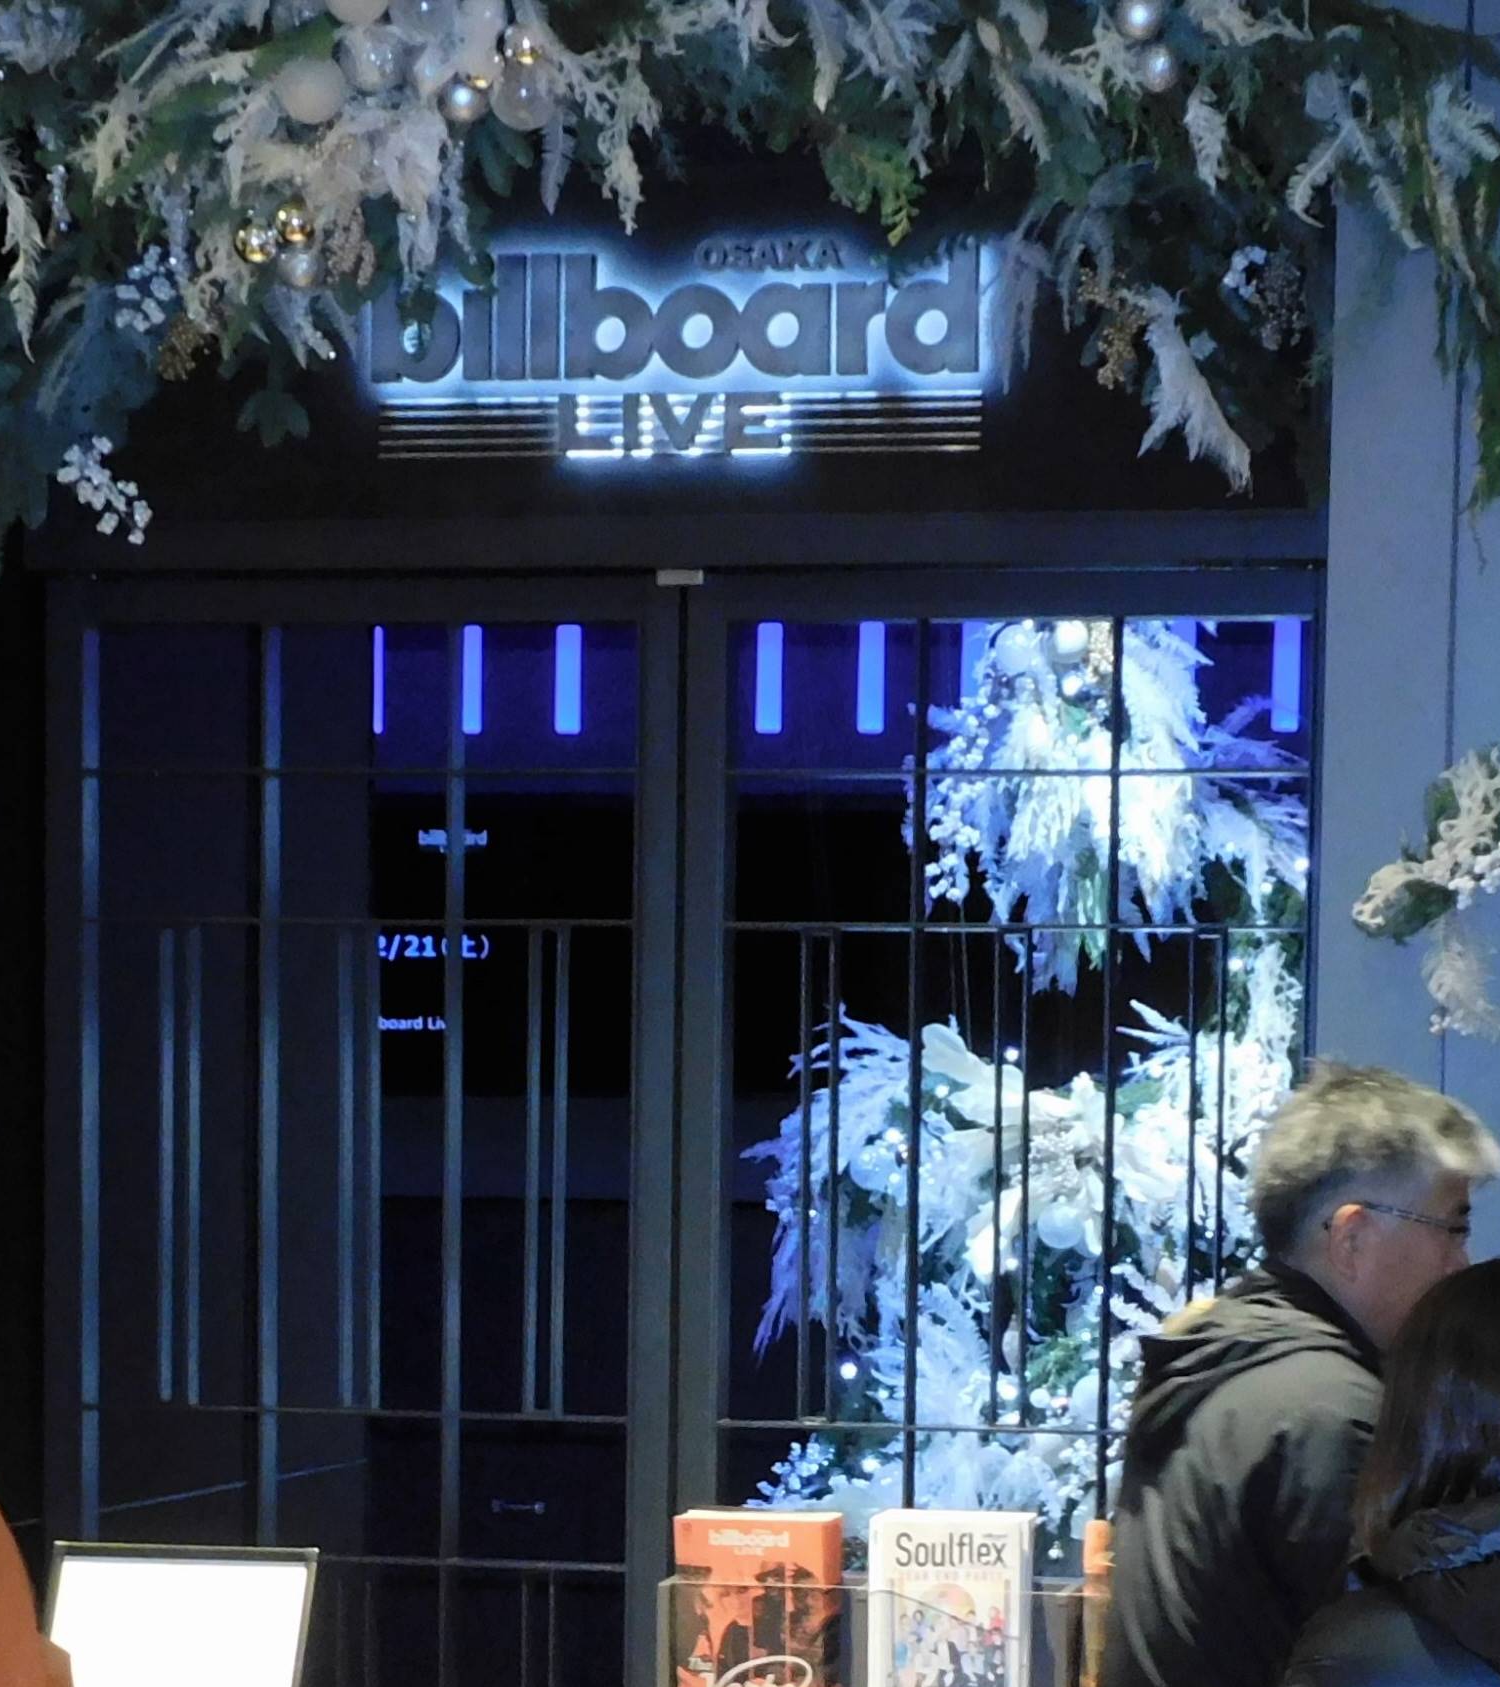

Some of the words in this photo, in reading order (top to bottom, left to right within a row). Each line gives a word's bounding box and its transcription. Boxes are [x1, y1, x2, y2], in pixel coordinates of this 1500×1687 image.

[696, 237, 845, 272] OSAKA
[370, 240, 981, 382] billboard
[559, 392, 791, 456] LIVE
[894, 1531, 1008, 1568] Soulflex
